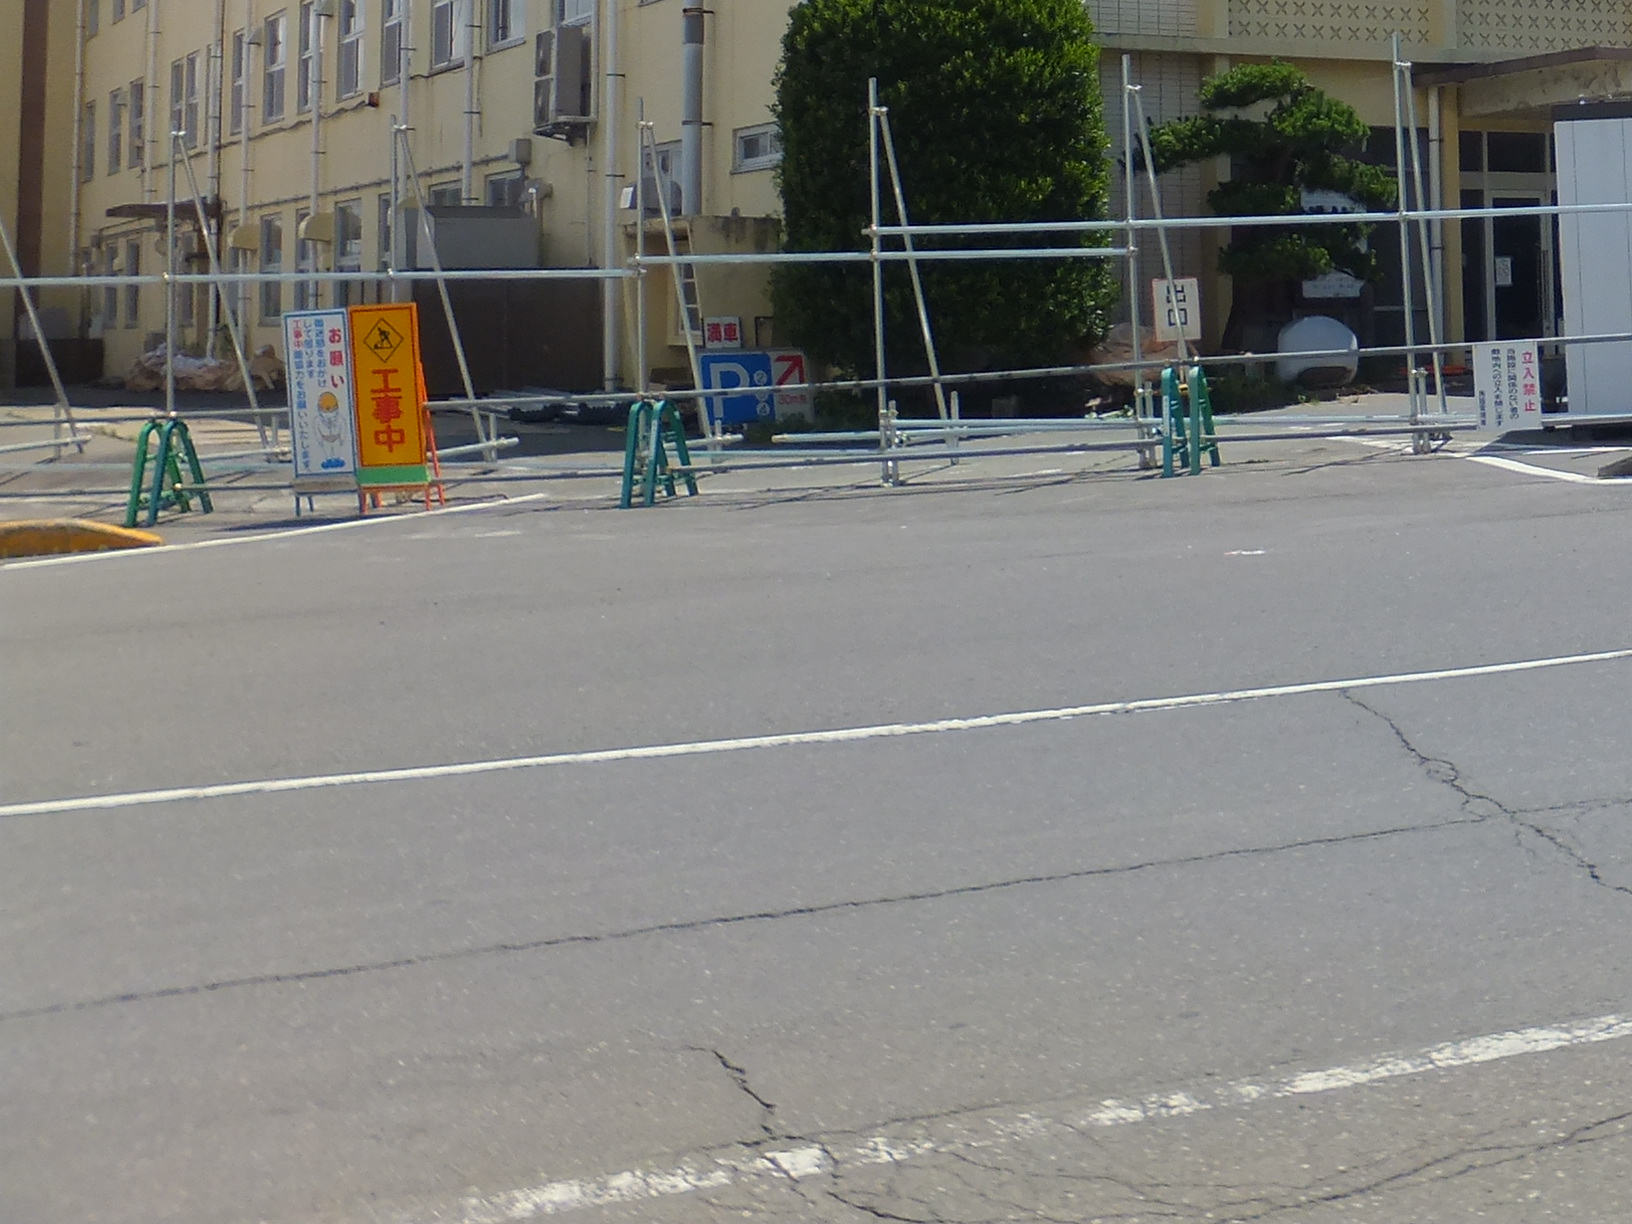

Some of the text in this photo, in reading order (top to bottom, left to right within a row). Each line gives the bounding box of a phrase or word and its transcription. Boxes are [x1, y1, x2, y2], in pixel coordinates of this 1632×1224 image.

[328, 328, 345, 388] お願い
[706, 322, 738, 343] 満車
[370, 368, 406, 453] 工事中
[709, 362, 751, 418] P
[1521, 351, 1536, 412] 立入禁止
